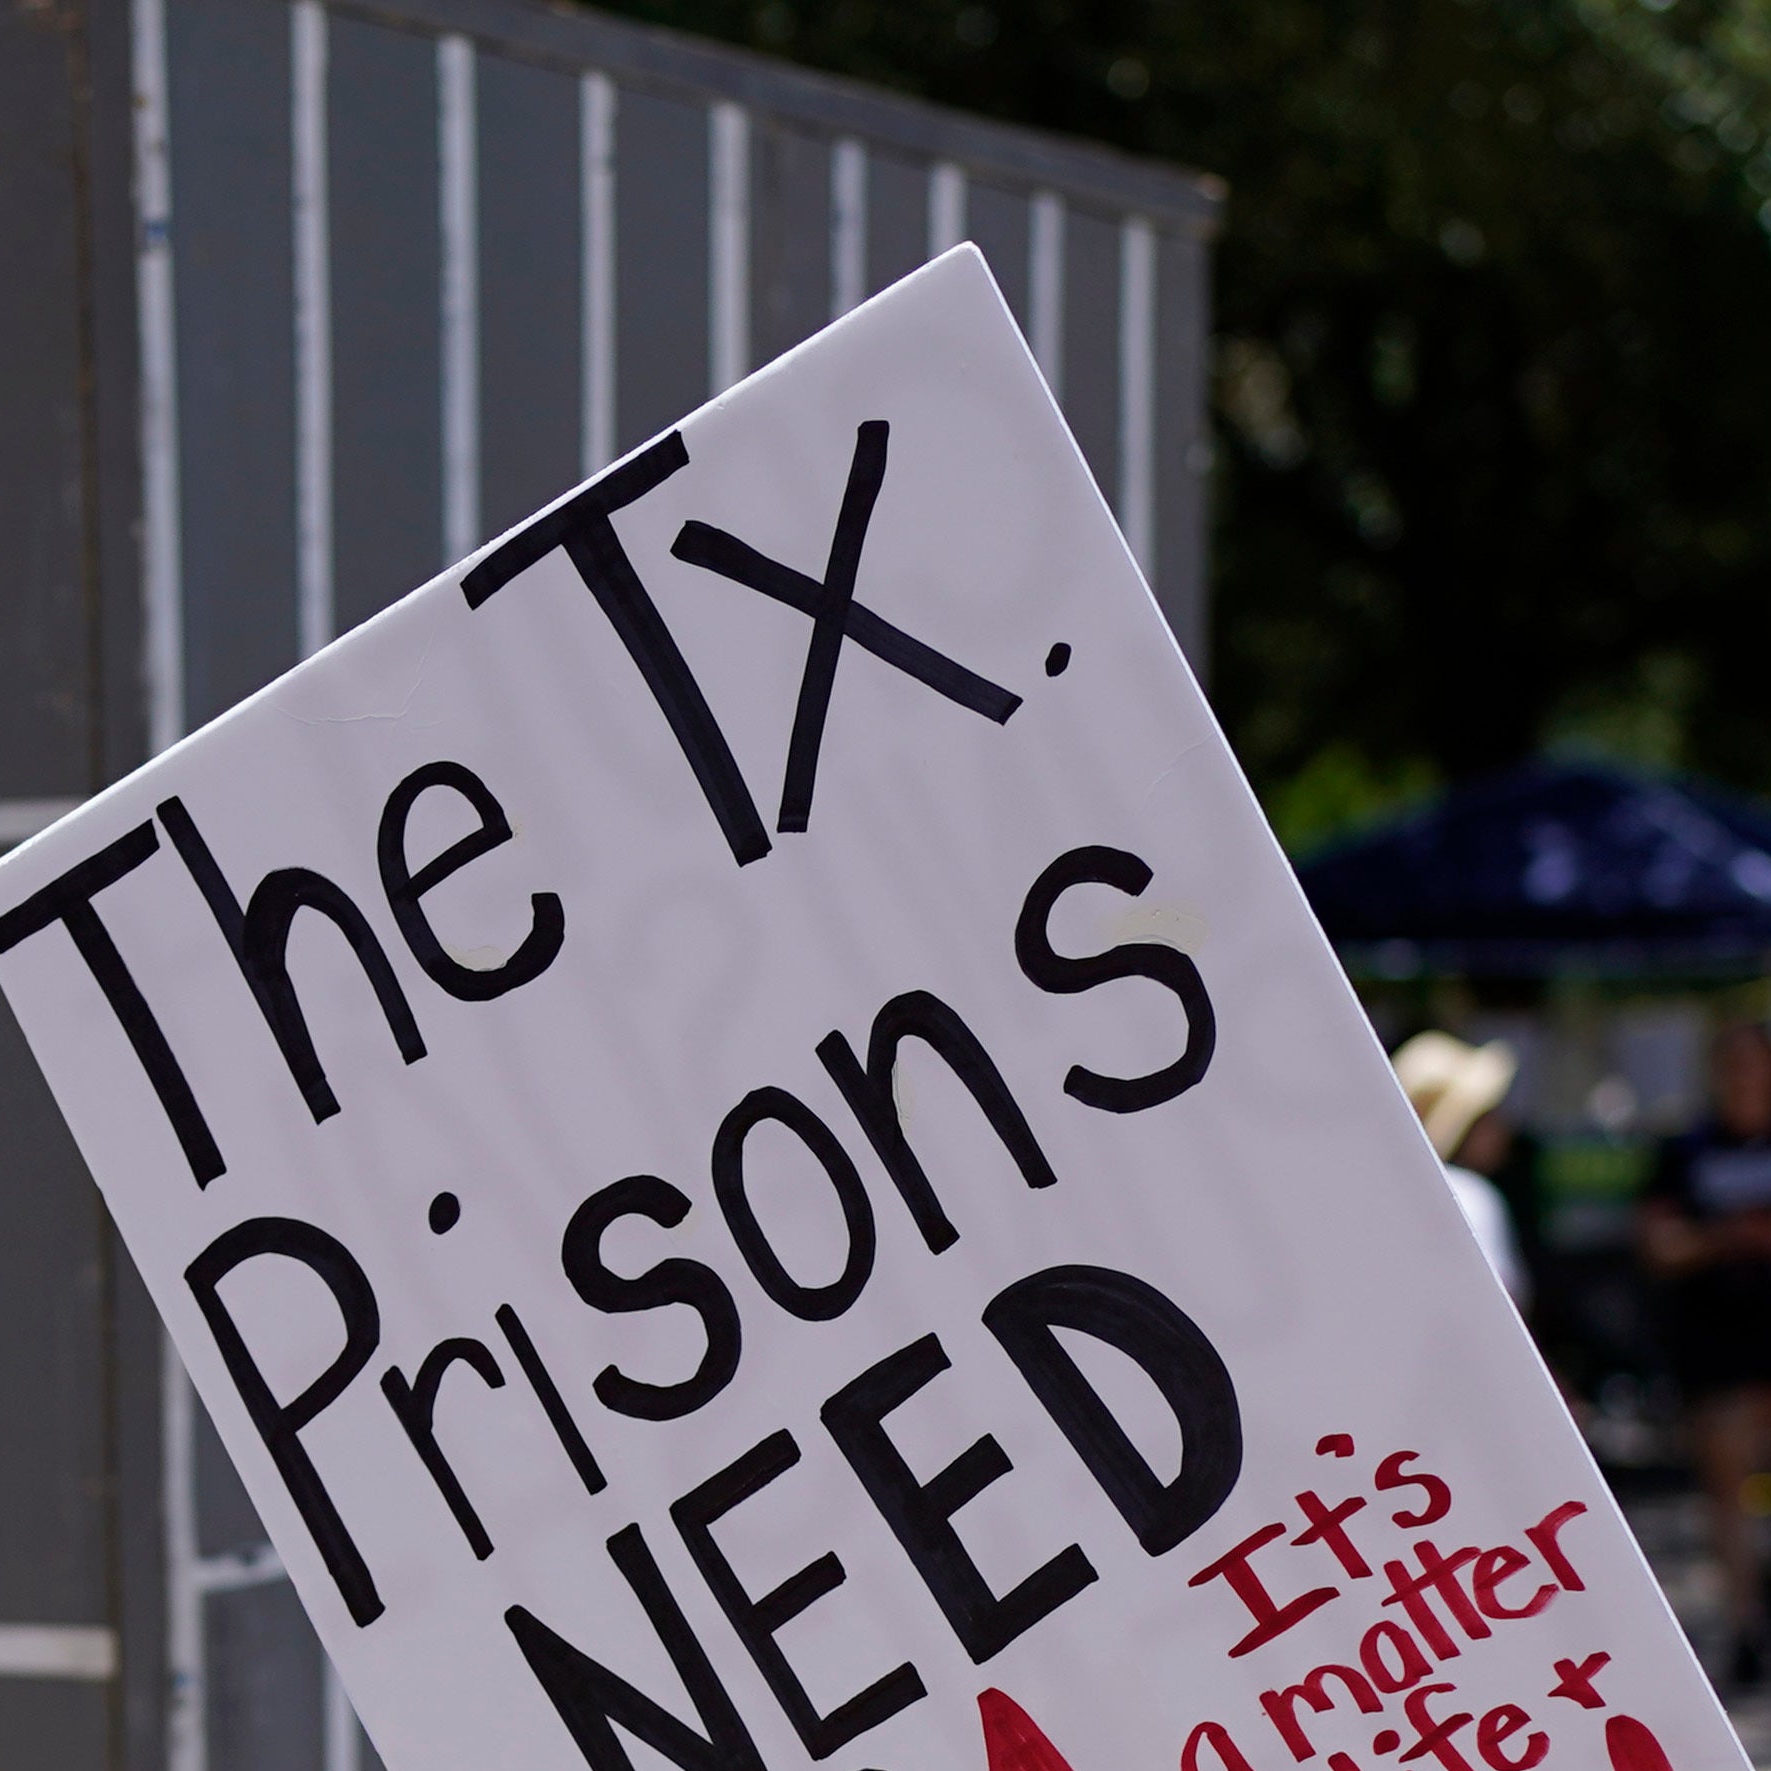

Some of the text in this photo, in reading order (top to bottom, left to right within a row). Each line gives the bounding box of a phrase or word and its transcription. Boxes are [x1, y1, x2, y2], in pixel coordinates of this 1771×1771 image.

[185, 845, 1216, 1626] Prisons
[1189, 1434, 1451, 1658] It's
[1261, 1501, 1588, 1762] matter
